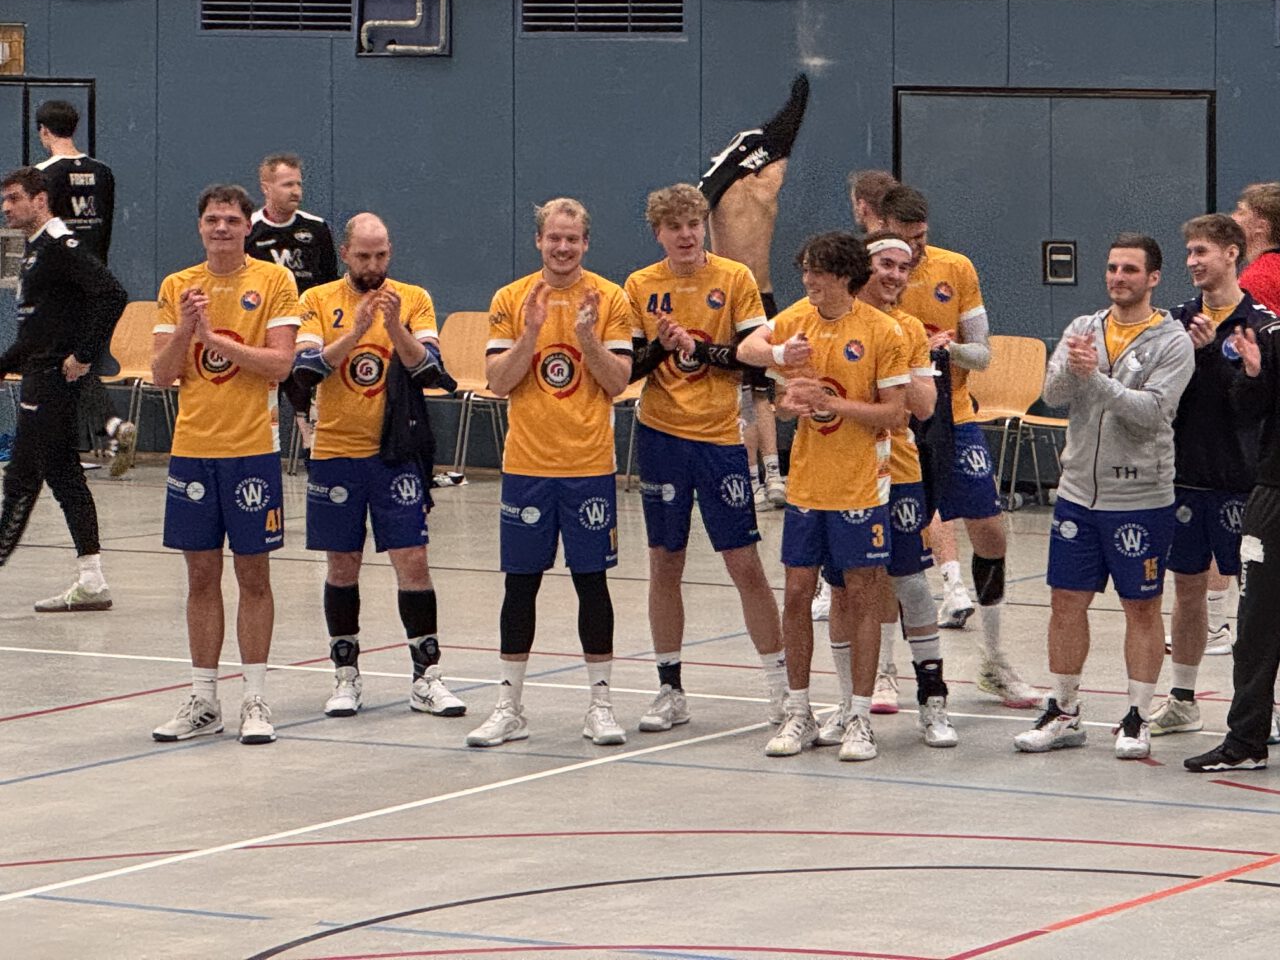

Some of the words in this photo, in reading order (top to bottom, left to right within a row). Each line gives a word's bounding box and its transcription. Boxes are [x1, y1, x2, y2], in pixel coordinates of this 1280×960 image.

[647, 292, 673, 315] 44
[332, 308, 344, 328] 2
[1112, 467, 1138, 479] TH
[872, 524, 884, 547] 3
